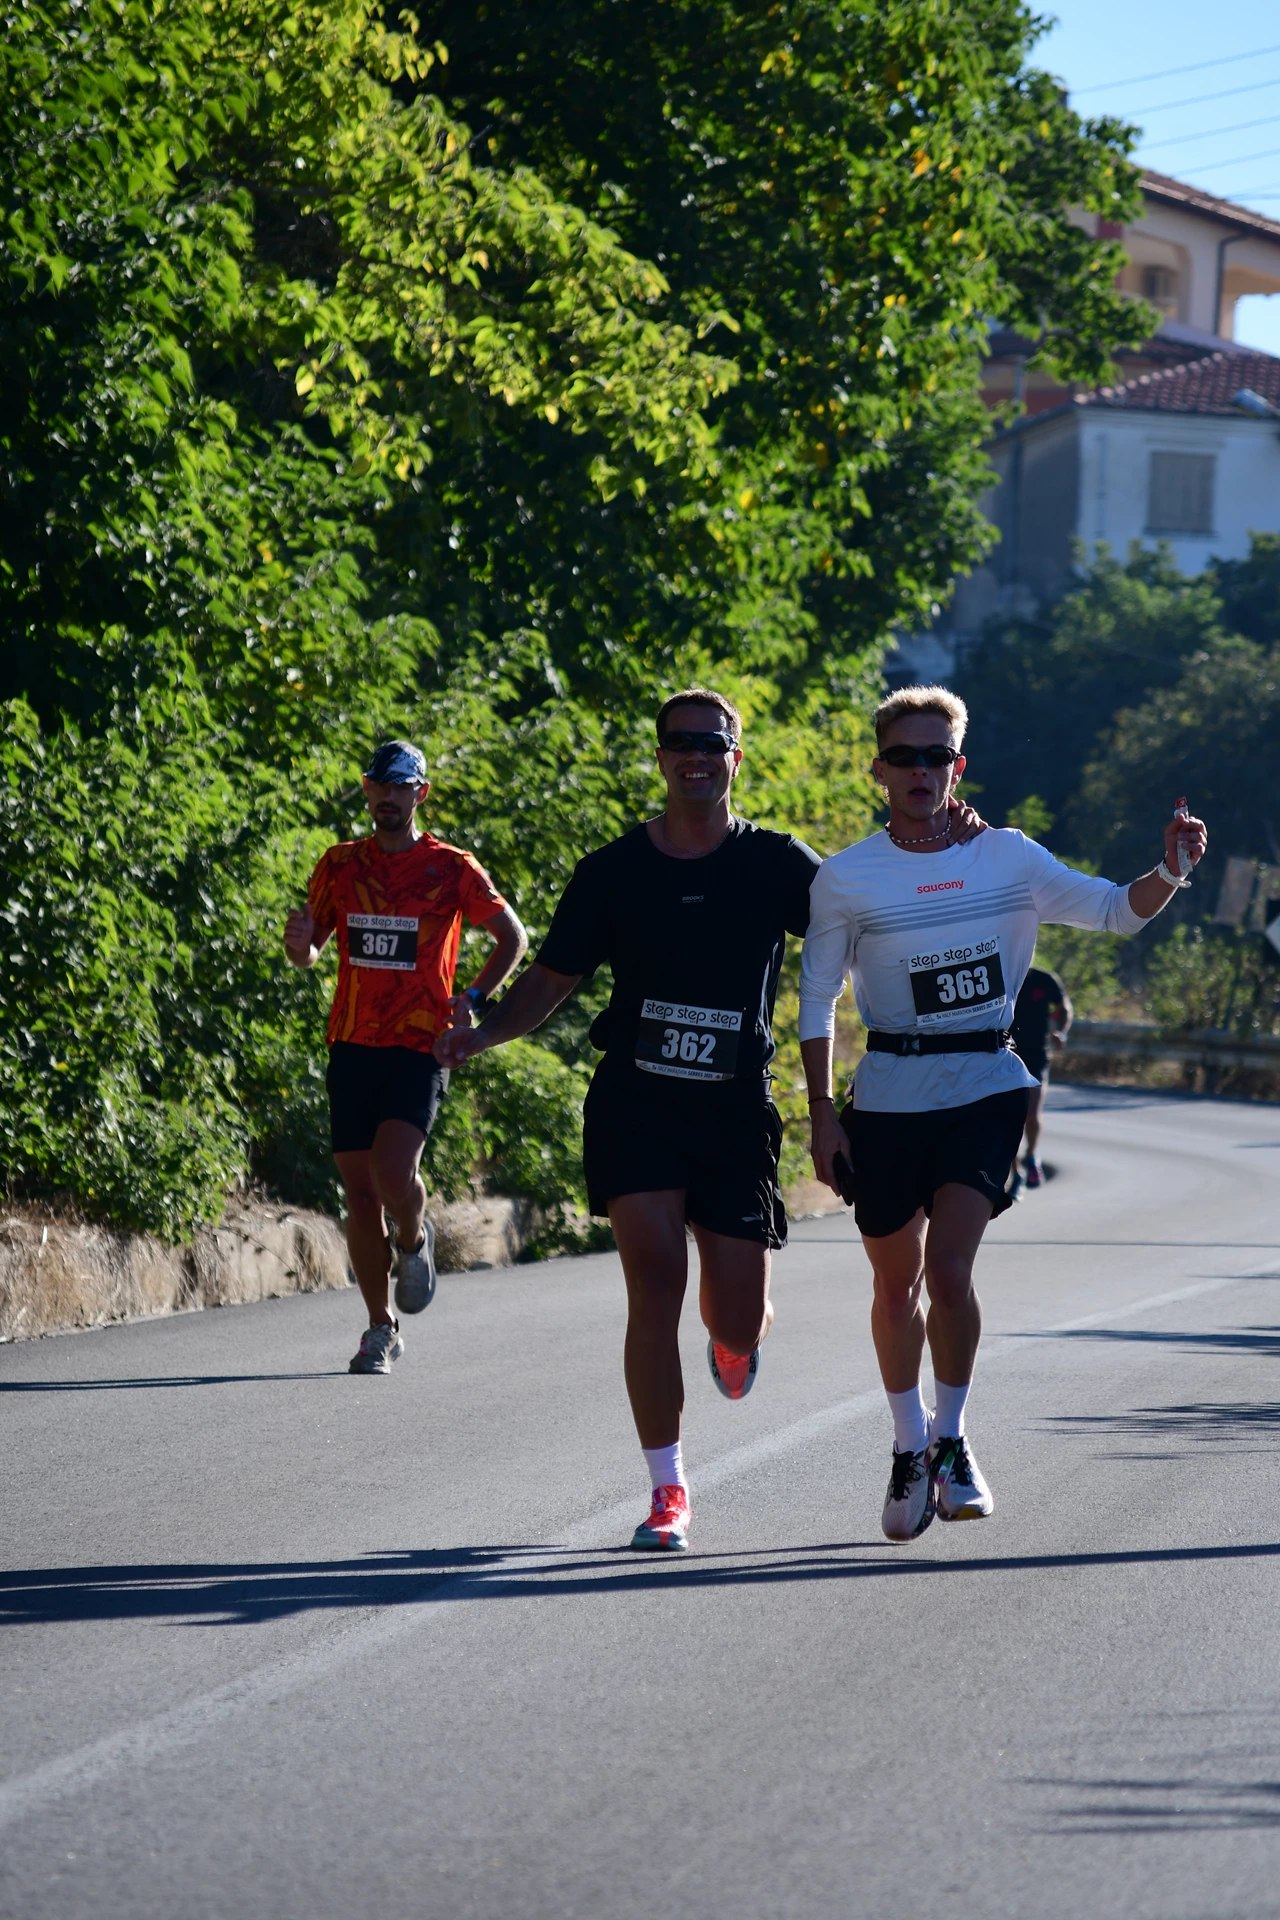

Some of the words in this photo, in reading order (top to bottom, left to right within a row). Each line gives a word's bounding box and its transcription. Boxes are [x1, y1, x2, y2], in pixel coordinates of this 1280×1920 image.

[917, 880, 964, 894] saucony
[348, 915, 368, 927] step
[371, 917, 391, 928] step
[394, 918, 416, 930] step
[362, 933, 398, 956] 367
[911, 954, 940, 968] step
[944, 947, 972, 961] step
[975, 939, 996, 955] step
[936, 965, 990, 1004] 363
[645, 1002, 673, 1019] step
[677, 1007, 706, 1024] step
[710, 1012, 739, 1028] step
[661, 1028, 716, 1064] 362
